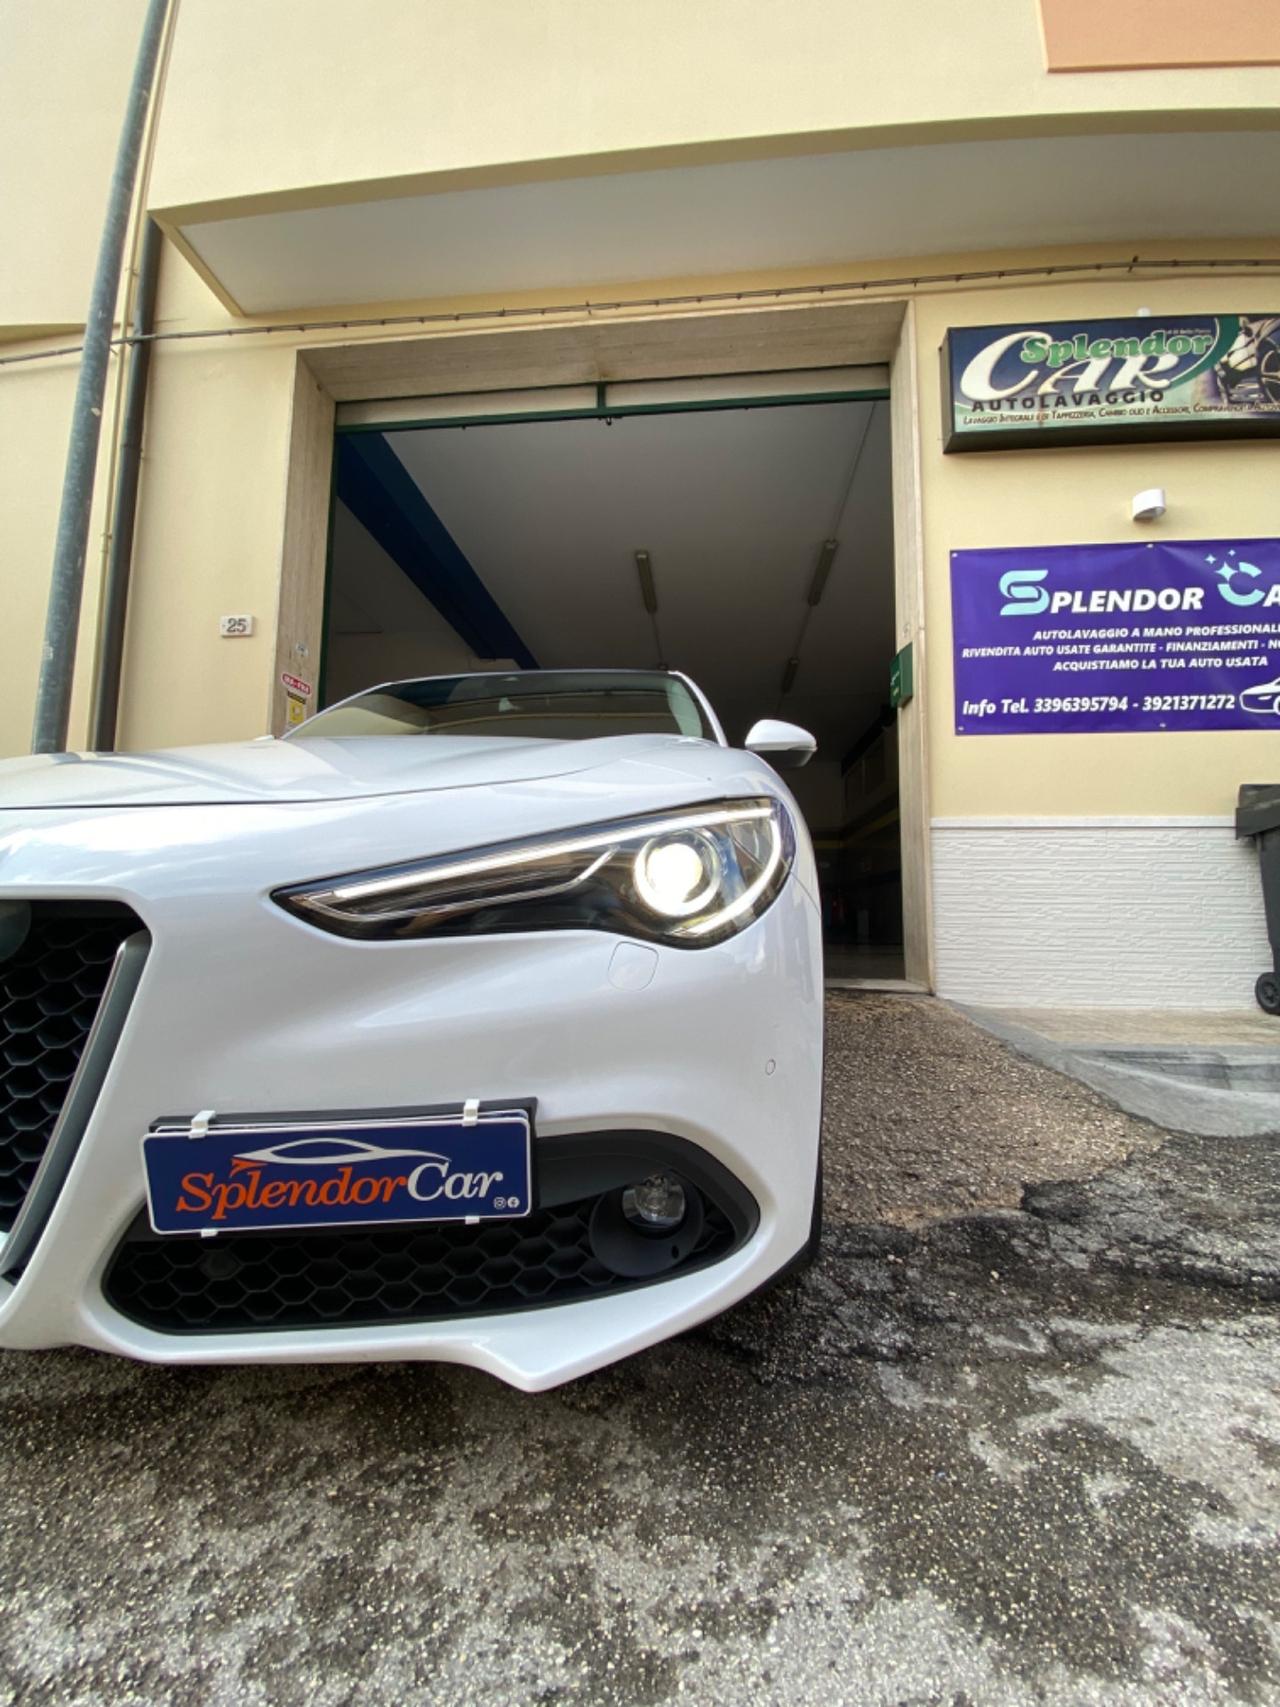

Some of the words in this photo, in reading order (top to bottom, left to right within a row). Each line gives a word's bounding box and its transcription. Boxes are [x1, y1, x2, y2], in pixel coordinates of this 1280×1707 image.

[1020, 330, 1213, 367] Splendor
[960, 331, 1180, 401] CAR
[972, 390, 1165, 412] AUTOLAVAGGIO
[1000, 570, 1204, 616] SPLENDOR
[227, 618, 247, 633] 25
[1033, 628, 1128, 640] AUTOLAVAGGIO
[1131, 628, 1140, 637] A
[1142, 626, 1183, 637] MANO
[1185, 623, 1280, 636] PROFESSIONAL
[962, 647, 1021, 658] RIVENDITA
[1023, 645, 1054, 656] AUTO
[1056, 644, 1090, 655] USATE
[1093, 642, 1156, 654] GARANTITE
[1166, 639, 1259, 652] FINANZIAMENTI
[1053, 659, 1139, 672] ACQUISTIAMO
[1142, 659, 1157, 669] LA
[1160, 658, 1186, 668] TUA
[1189, 657, 1222, 668] AUTO
[1226, 656, 1268, 666] USATA
[963, 700, 996, 717] Info
[1001, 698, 1030, 714] Tel.
[1034, 696, 1129, 713] 3396395794
[1143, 694, 1236, 711] 3921371272
